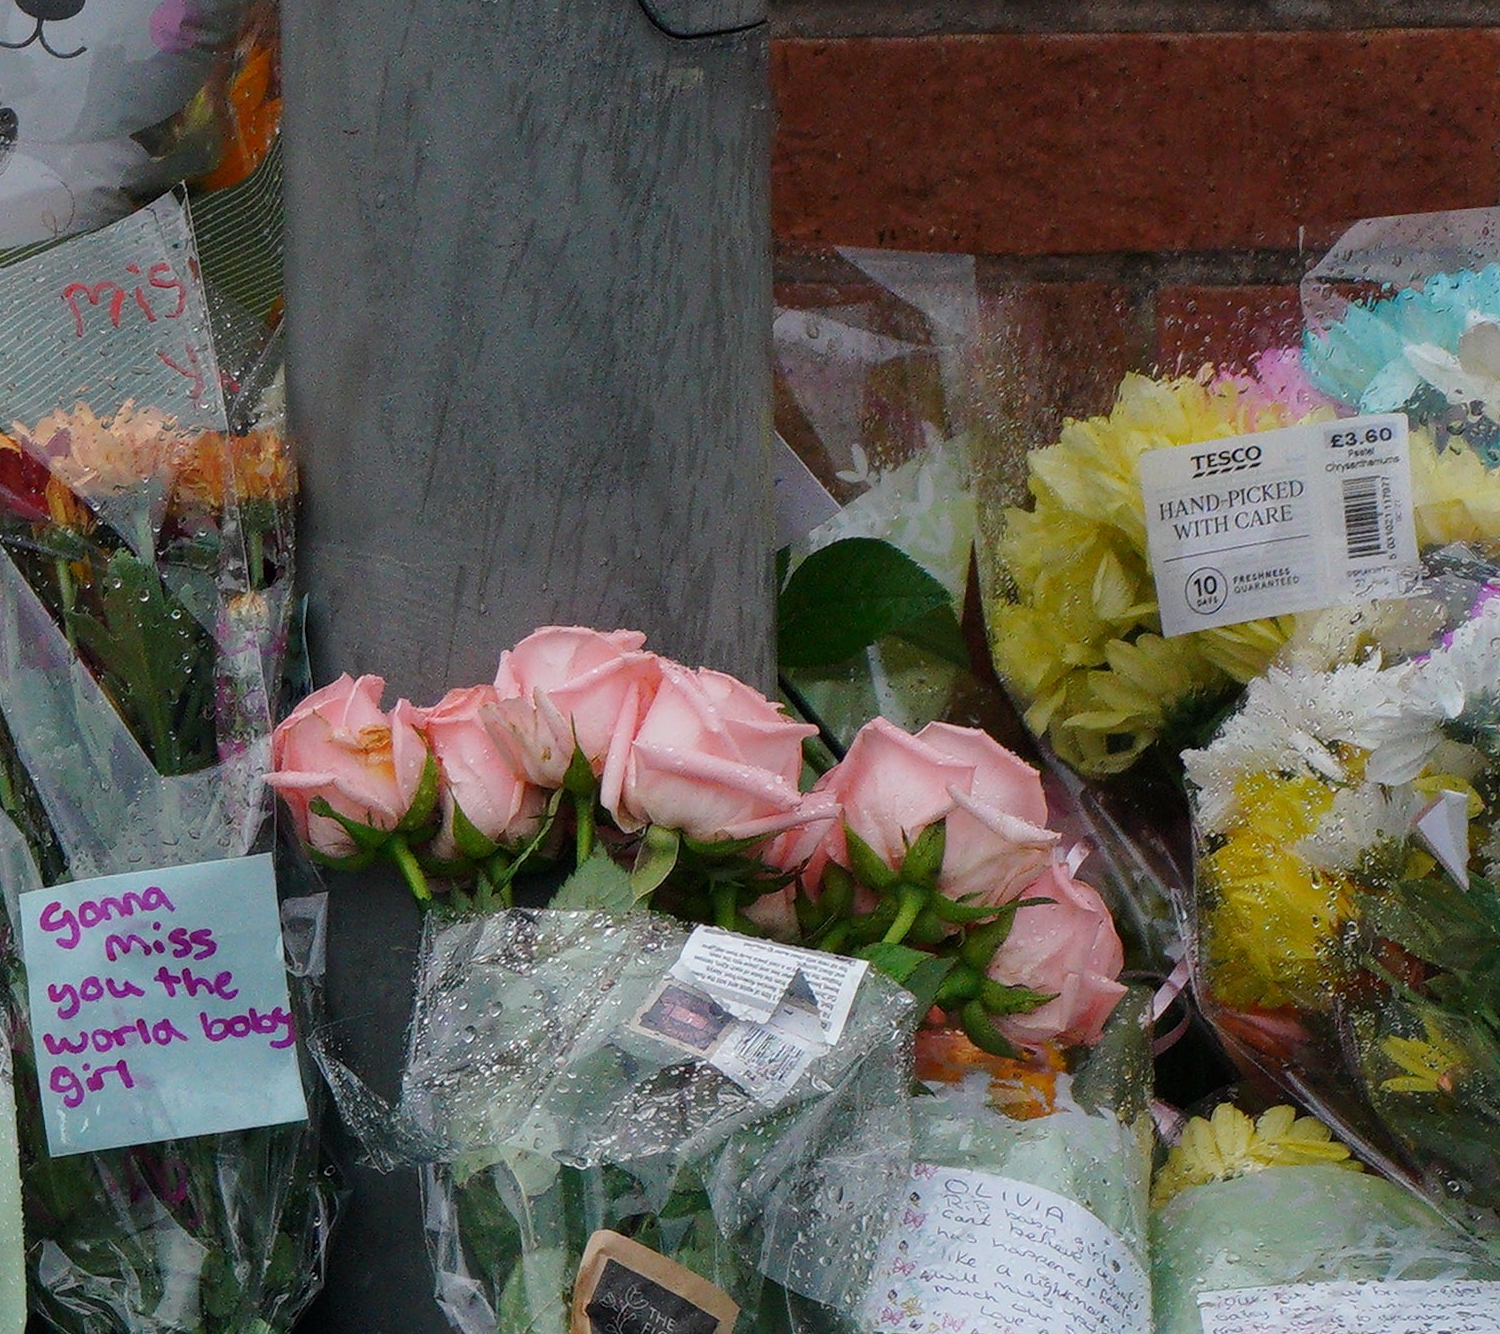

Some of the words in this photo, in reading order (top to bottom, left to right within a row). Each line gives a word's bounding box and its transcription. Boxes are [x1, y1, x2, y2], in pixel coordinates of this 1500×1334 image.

[61, 257, 200, 338] mis
[1330, 427, 1393, 449] £3.60
[1190, 444, 1263, 471] TESCO
[1158, 478, 1305, 521] HAND-PICKED
[1173, 515, 1230, 540] WITH
[1233, 504, 1294, 529] CARE
[1192, 575, 1218, 596] 10
[1232, 566, 1291, 585] FRESHNESS
[1196, 597, 1219, 607] DAYS
[47, 975, 146, 1020] you
[153, 966, 239, 1000] the
[49, 1059, 135, 1109] girl
[944, 1178, 1066, 1224] OLIVIA
[649, 1306, 678, 1332] THE
